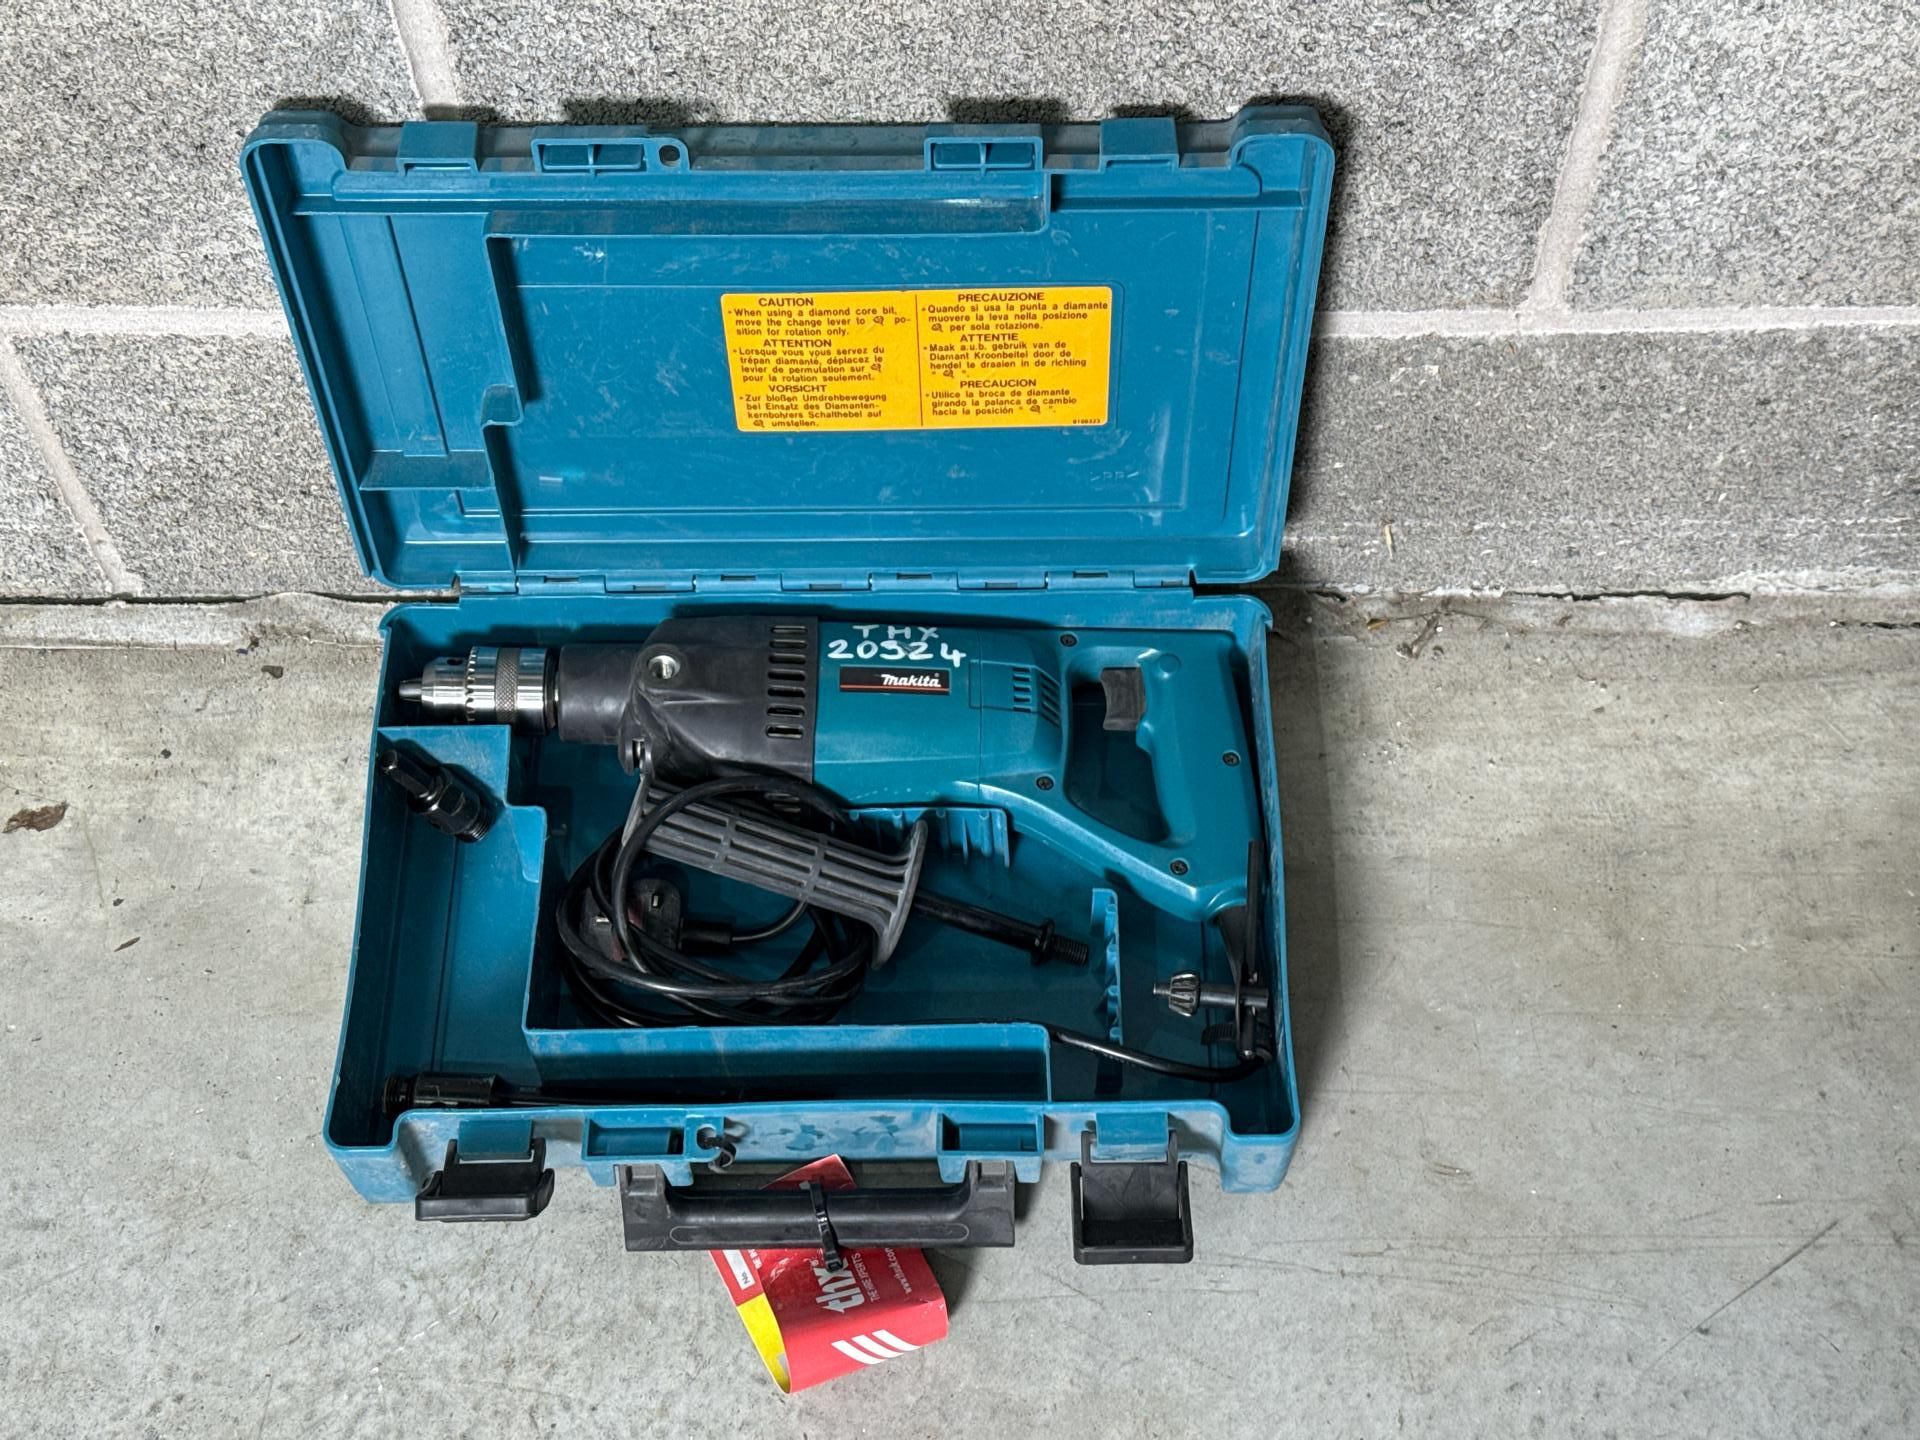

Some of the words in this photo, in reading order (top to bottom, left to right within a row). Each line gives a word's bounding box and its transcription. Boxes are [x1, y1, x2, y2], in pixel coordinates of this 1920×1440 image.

[957, 292, 1045, 302] PRECAUZIONE
[758, 298, 814, 307] CAUTION
[928, 304, 965, 313] Quando
[1006, 303, 1014, 311] la
[1020, 302, 1047, 312] punta
[1063, 301, 1108, 310] diamante
[734, 308, 762, 317] When
[767, 309, 792, 318] using
[809, 307, 850, 317] diamond
[928, 314, 971, 322] muovere
[975, 313, 984, 321] la
[989, 313, 1009, 321] leva
[1014, 312, 1037, 320] nella
[1042, 312, 1088, 322] posizione
[767, 318, 782, 326] the
[787, 318, 822, 328] change
[827, 317, 850, 326] lever
[856, 317, 865, 325] to
[894, 316, 911, 325] po-
[736, 328, 762, 336] sition
[767, 328, 780, 336] for
[785, 328, 821, 336] rotation
[950, 324, 965, 333] per
[970, 322, 990, 331] sola
[995, 322, 1043, 331] rotazione.
[960, 333, 1019, 342] ATTENTIE
[763, 338, 832, 348] ATTENTION
[929, 344, 955, 352] Maak
[992, 341, 1027, 352] gebruik
[739, 347, 777, 357] Lorsque
[809, 349, 831, 357] vous
[836, 347, 868, 355] servez
[873, 345, 885, 353] du
[930, 352, 969, 361] Diamant
[974, 350, 1028, 360] Kroonbeitel
[1033, 350, 1054, 358] door
[740, 357, 770, 365] trépan
[827, 356, 869, 366] déplacez
[930, 361, 961, 370] hendel
[967, 361, 975, 369] te
[980, 360, 1016, 368] draaien
[1021, 359, 1029, 367] in
[1035, 359, 1046, 367] de
[1051, 357, 1087, 367] richting
[741, 365, 767, 373] levier
[789, 366, 845, 374] permutation
[743, 375, 763, 383] pour
[769, 374, 777, 382] la
[822, 373, 875, 382] seulement.
[768, 384, 827, 393] VORSICHT
[960, 379, 1037, 388] PRECAUCION
[745, 394, 761, 402] Zur
[802, 394, 887, 402] Umdrehbewegung
[932, 391, 961, 399] Utilice
[979, 390, 1005, 398] broca
[1010, 389, 1022, 397] de
[1027, 388, 1070, 396] diamante
[765, 403, 799, 411] Einsatz
[825, 402, 880, 410] Diamanten-
[932, 399, 967, 408] girando
[985, 399, 1021, 407] palanca
[1042, 396, 1077, 404] cambio
[747, 411, 803, 419] kernbohrers
[808, 411, 863, 419] Schalthebel
[867, 410, 882, 418] auf
[932, 408, 957, 416] hacia
[975, 407, 1014, 416] posición
[771, 420, 819, 428] umstellen.
[852, 624, 939, 640] THX
[827, 639, 966, 668] 20524
